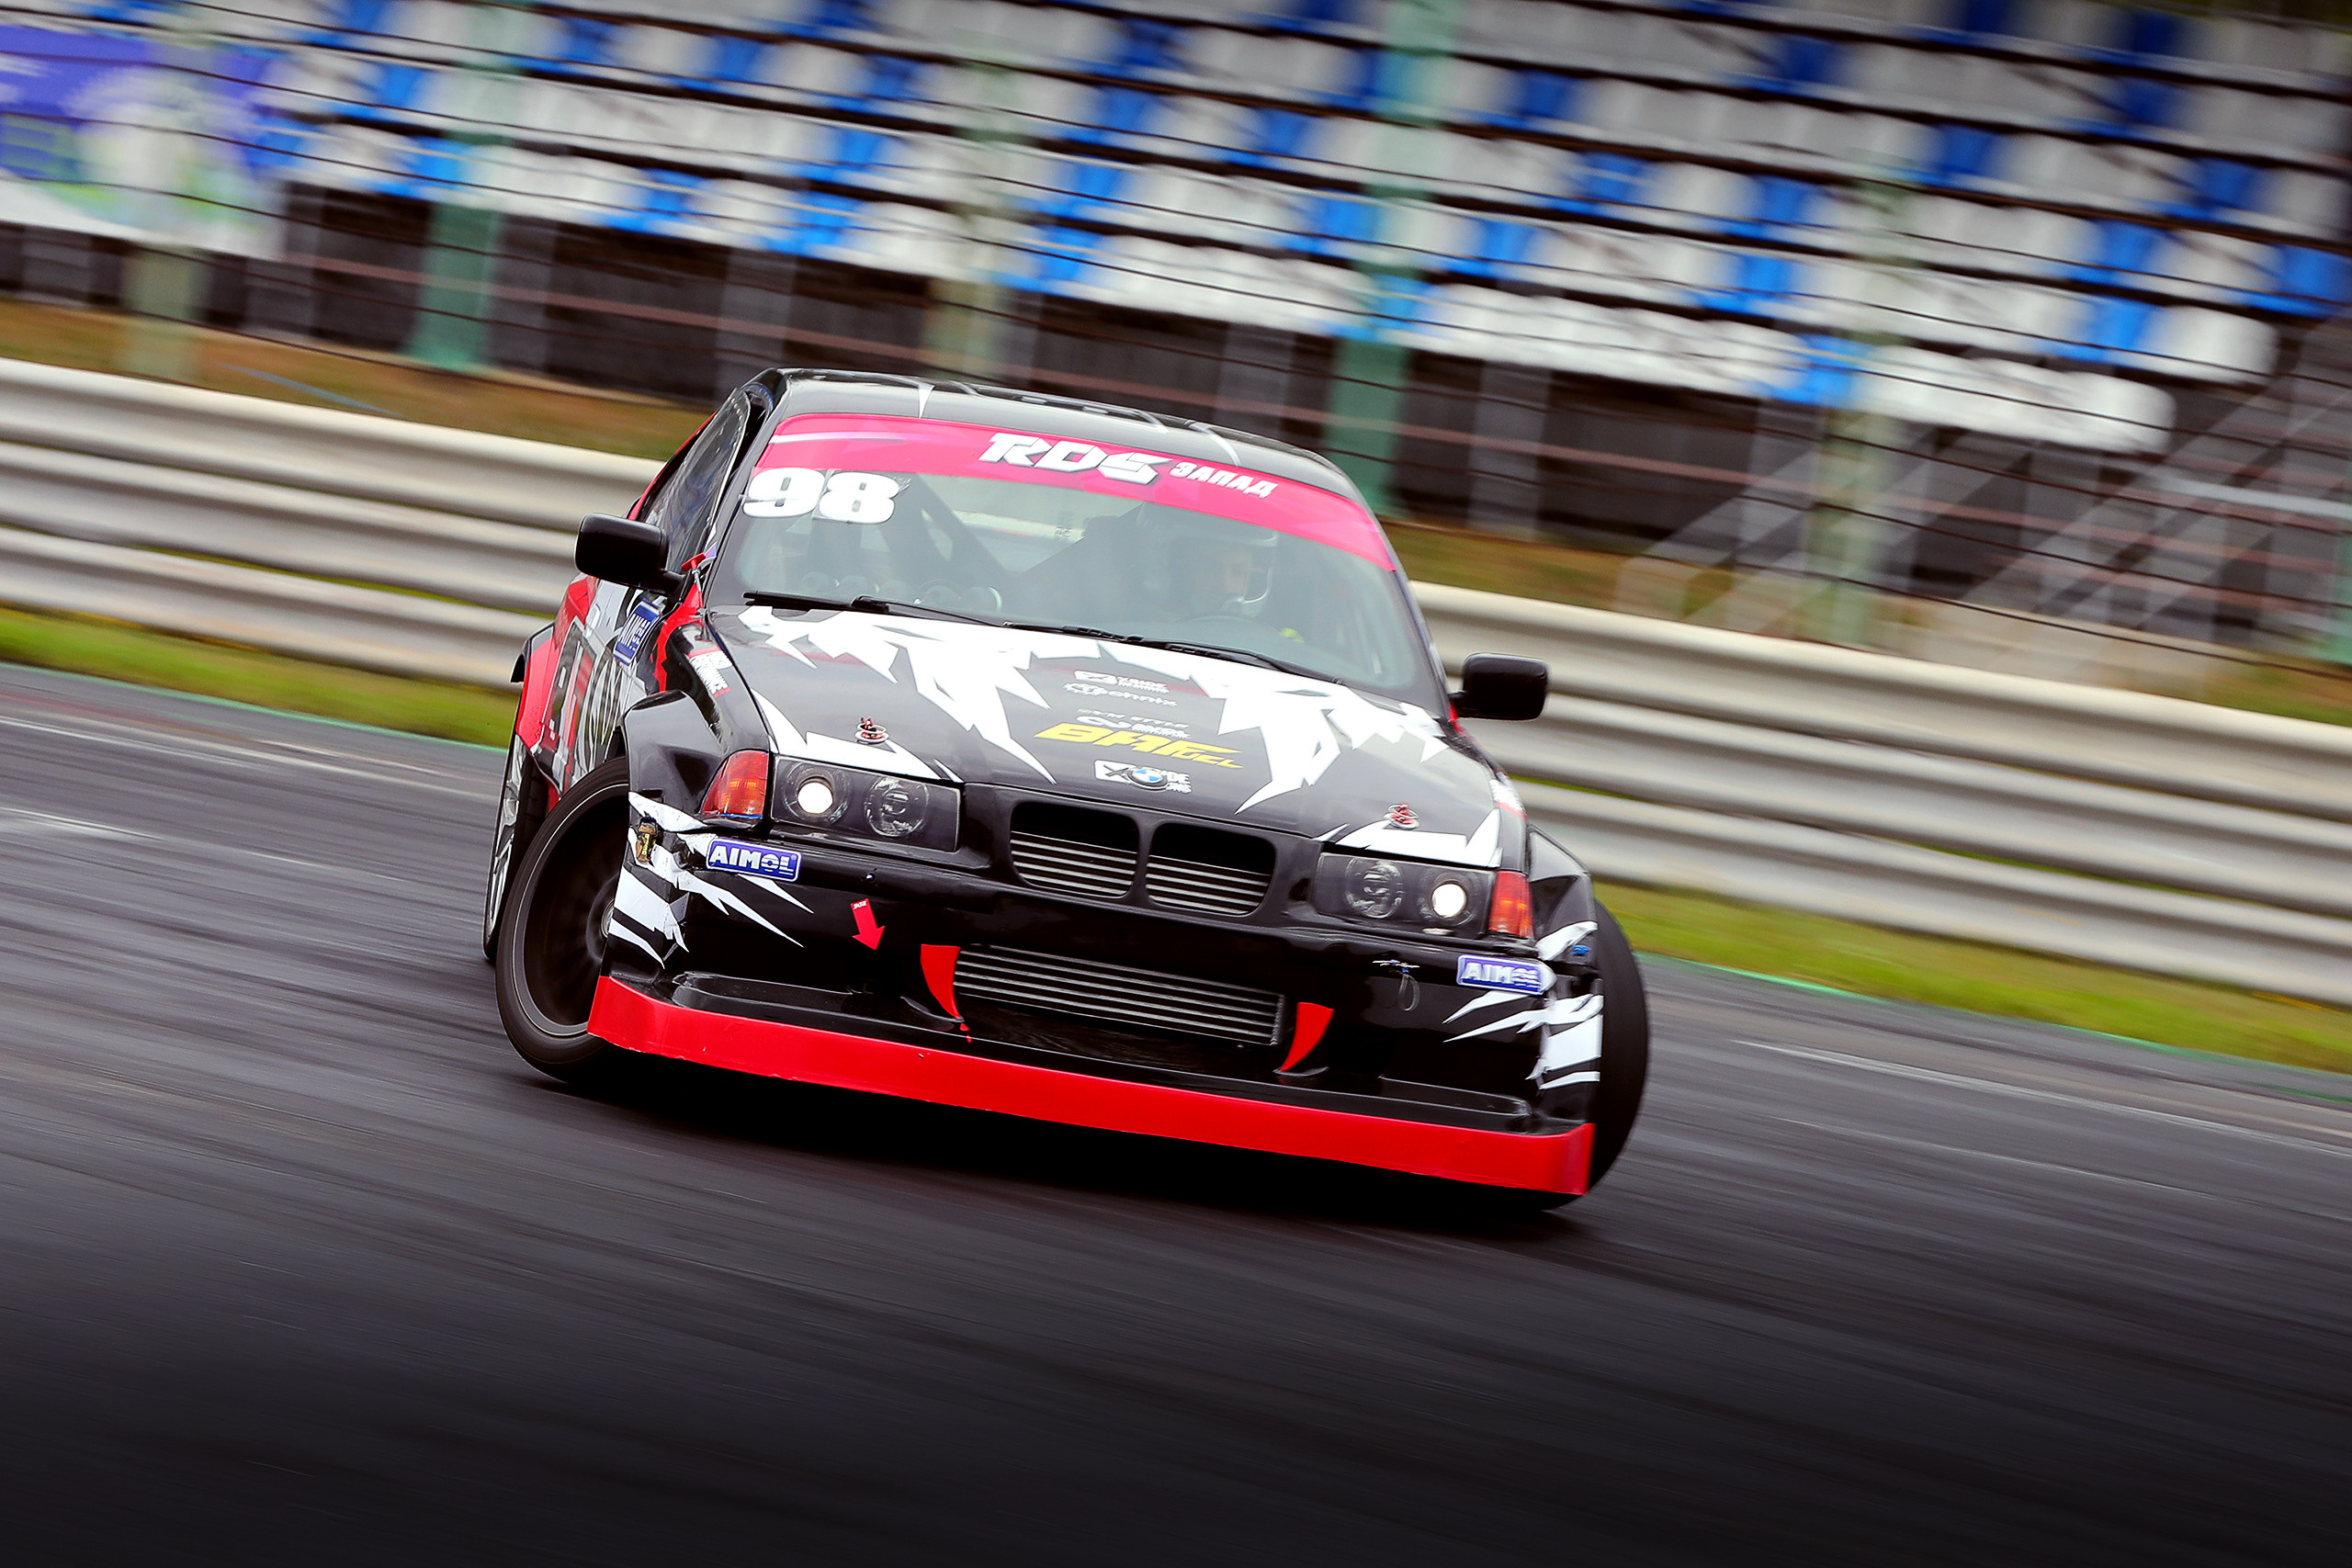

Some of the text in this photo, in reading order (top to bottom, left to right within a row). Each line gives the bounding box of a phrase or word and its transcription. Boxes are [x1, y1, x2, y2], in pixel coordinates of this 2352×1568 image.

[978, 432, 1278, 499] RDS ЗАПАД
[742, 467, 899, 525] 98
[709, 845, 795, 876] AIMOL
